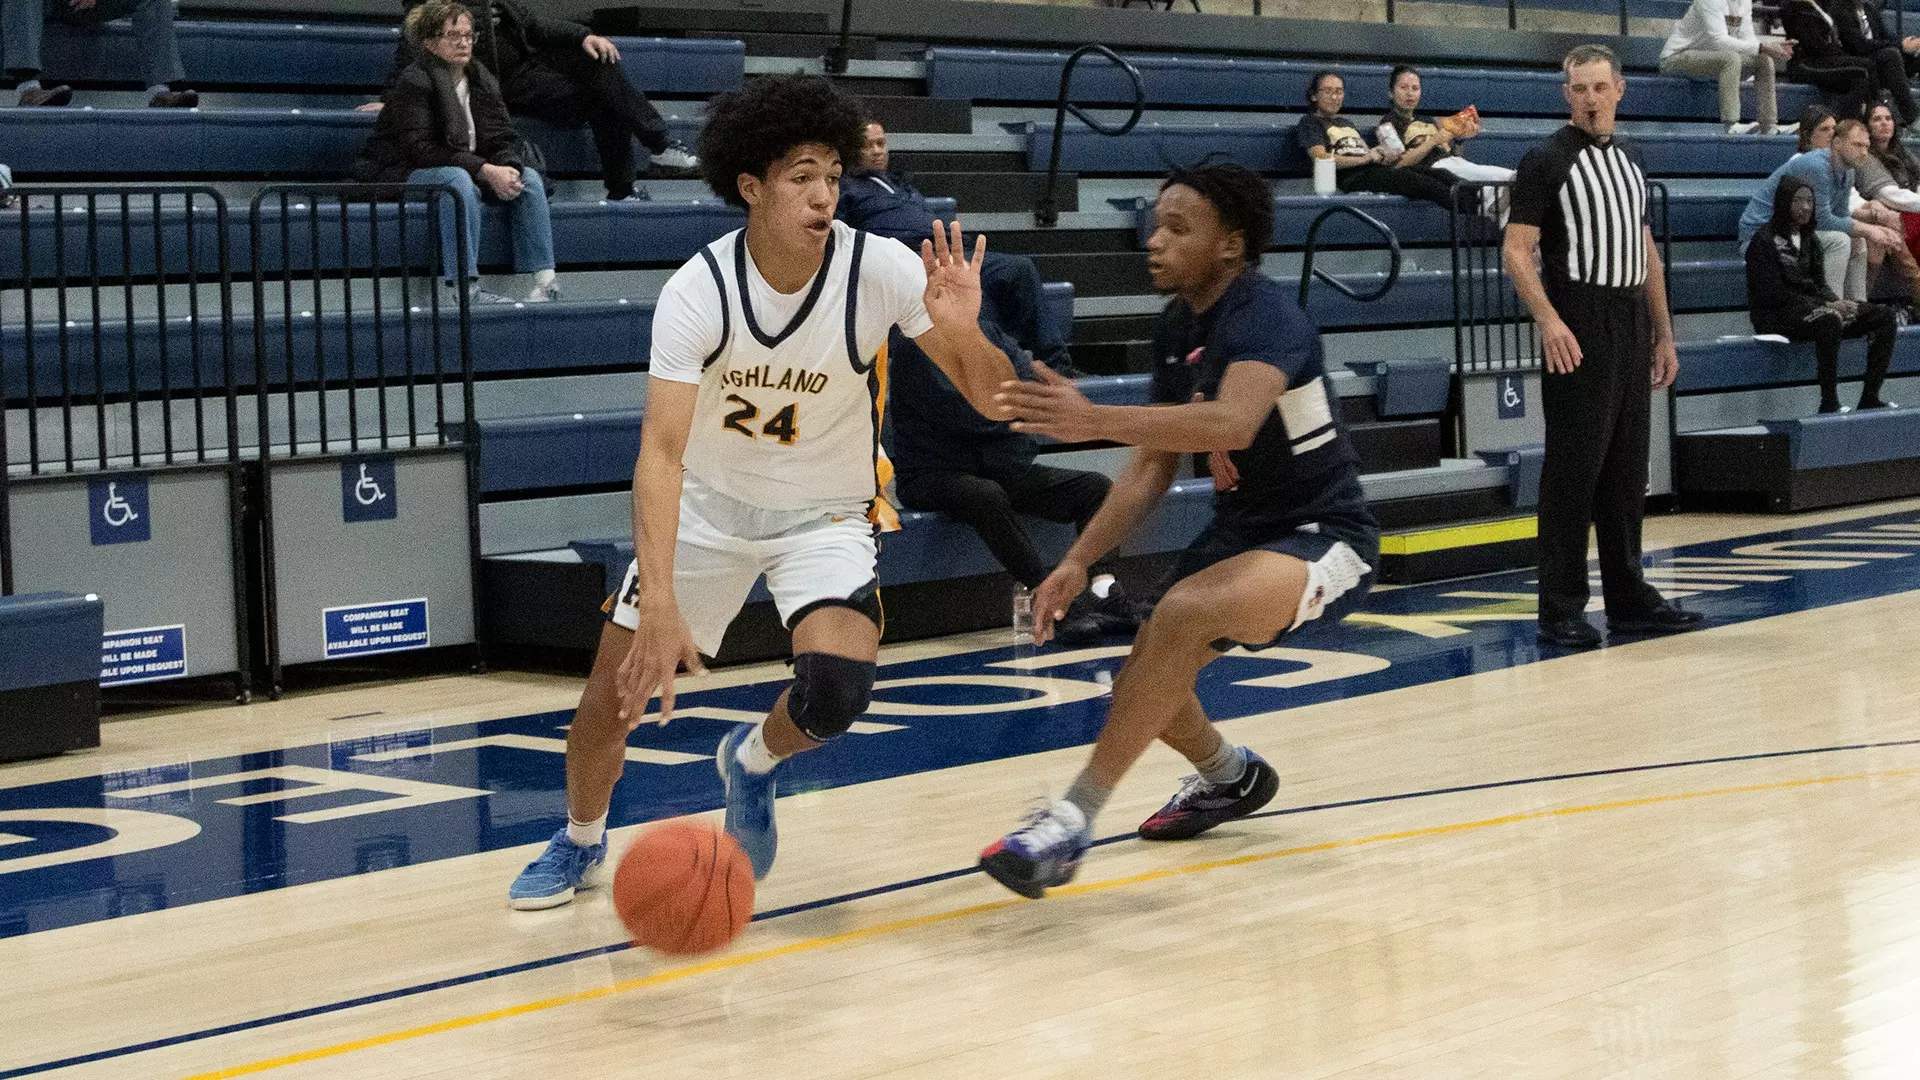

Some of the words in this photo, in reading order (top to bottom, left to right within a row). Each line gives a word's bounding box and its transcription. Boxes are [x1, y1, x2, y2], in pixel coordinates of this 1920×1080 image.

[722, 394, 799, 446] 24
[343, 610, 389, 622] COMPANION
[390, 608, 409, 617] SEAT
[350, 625, 369, 634] WILL
[370, 624, 381, 633] BE
[382, 621, 403, 631] MADE
[102, 638, 141, 649] MPANION
[142, 635, 164, 645] SEAT
[328, 638, 368, 650] AVAILABLE
[370, 635, 391, 645] UPON
[393, 632, 427, 642] REQUEST
[120, 652, 132, 661] BE
[133, 649, 158, 659] MADE
[120, 665, 144, 675] UPON
[145, 660, 184, 672] REQUEST
